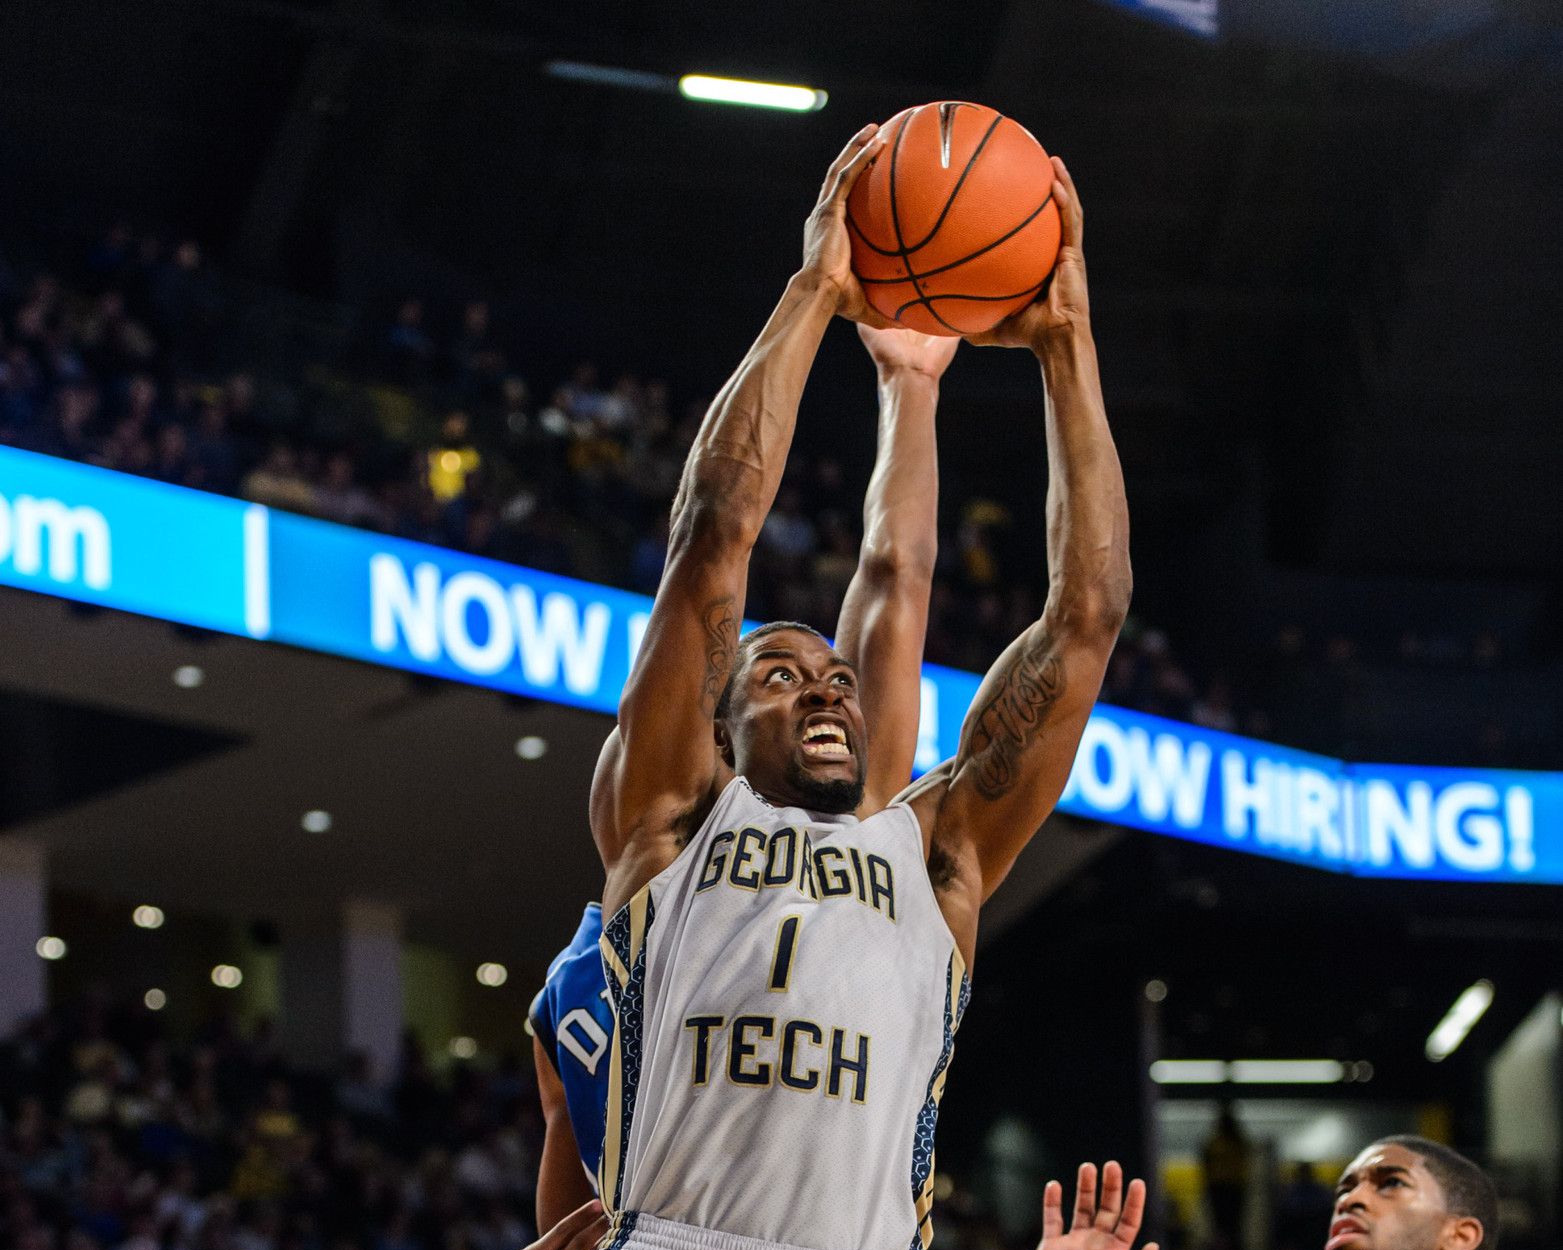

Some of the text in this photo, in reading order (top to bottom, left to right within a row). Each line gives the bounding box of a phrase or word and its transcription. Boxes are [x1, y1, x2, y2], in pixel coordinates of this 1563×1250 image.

[370, 552, 612, 697] NOW
[1060, 714, 1212, 830] OW
[1220, 748, 1536, 872] HIRING!
[695, 825, 897, 925] GEORGIA
[767, 914, 802, 993] 1
[684, 1014, 871, 1105] TECH
